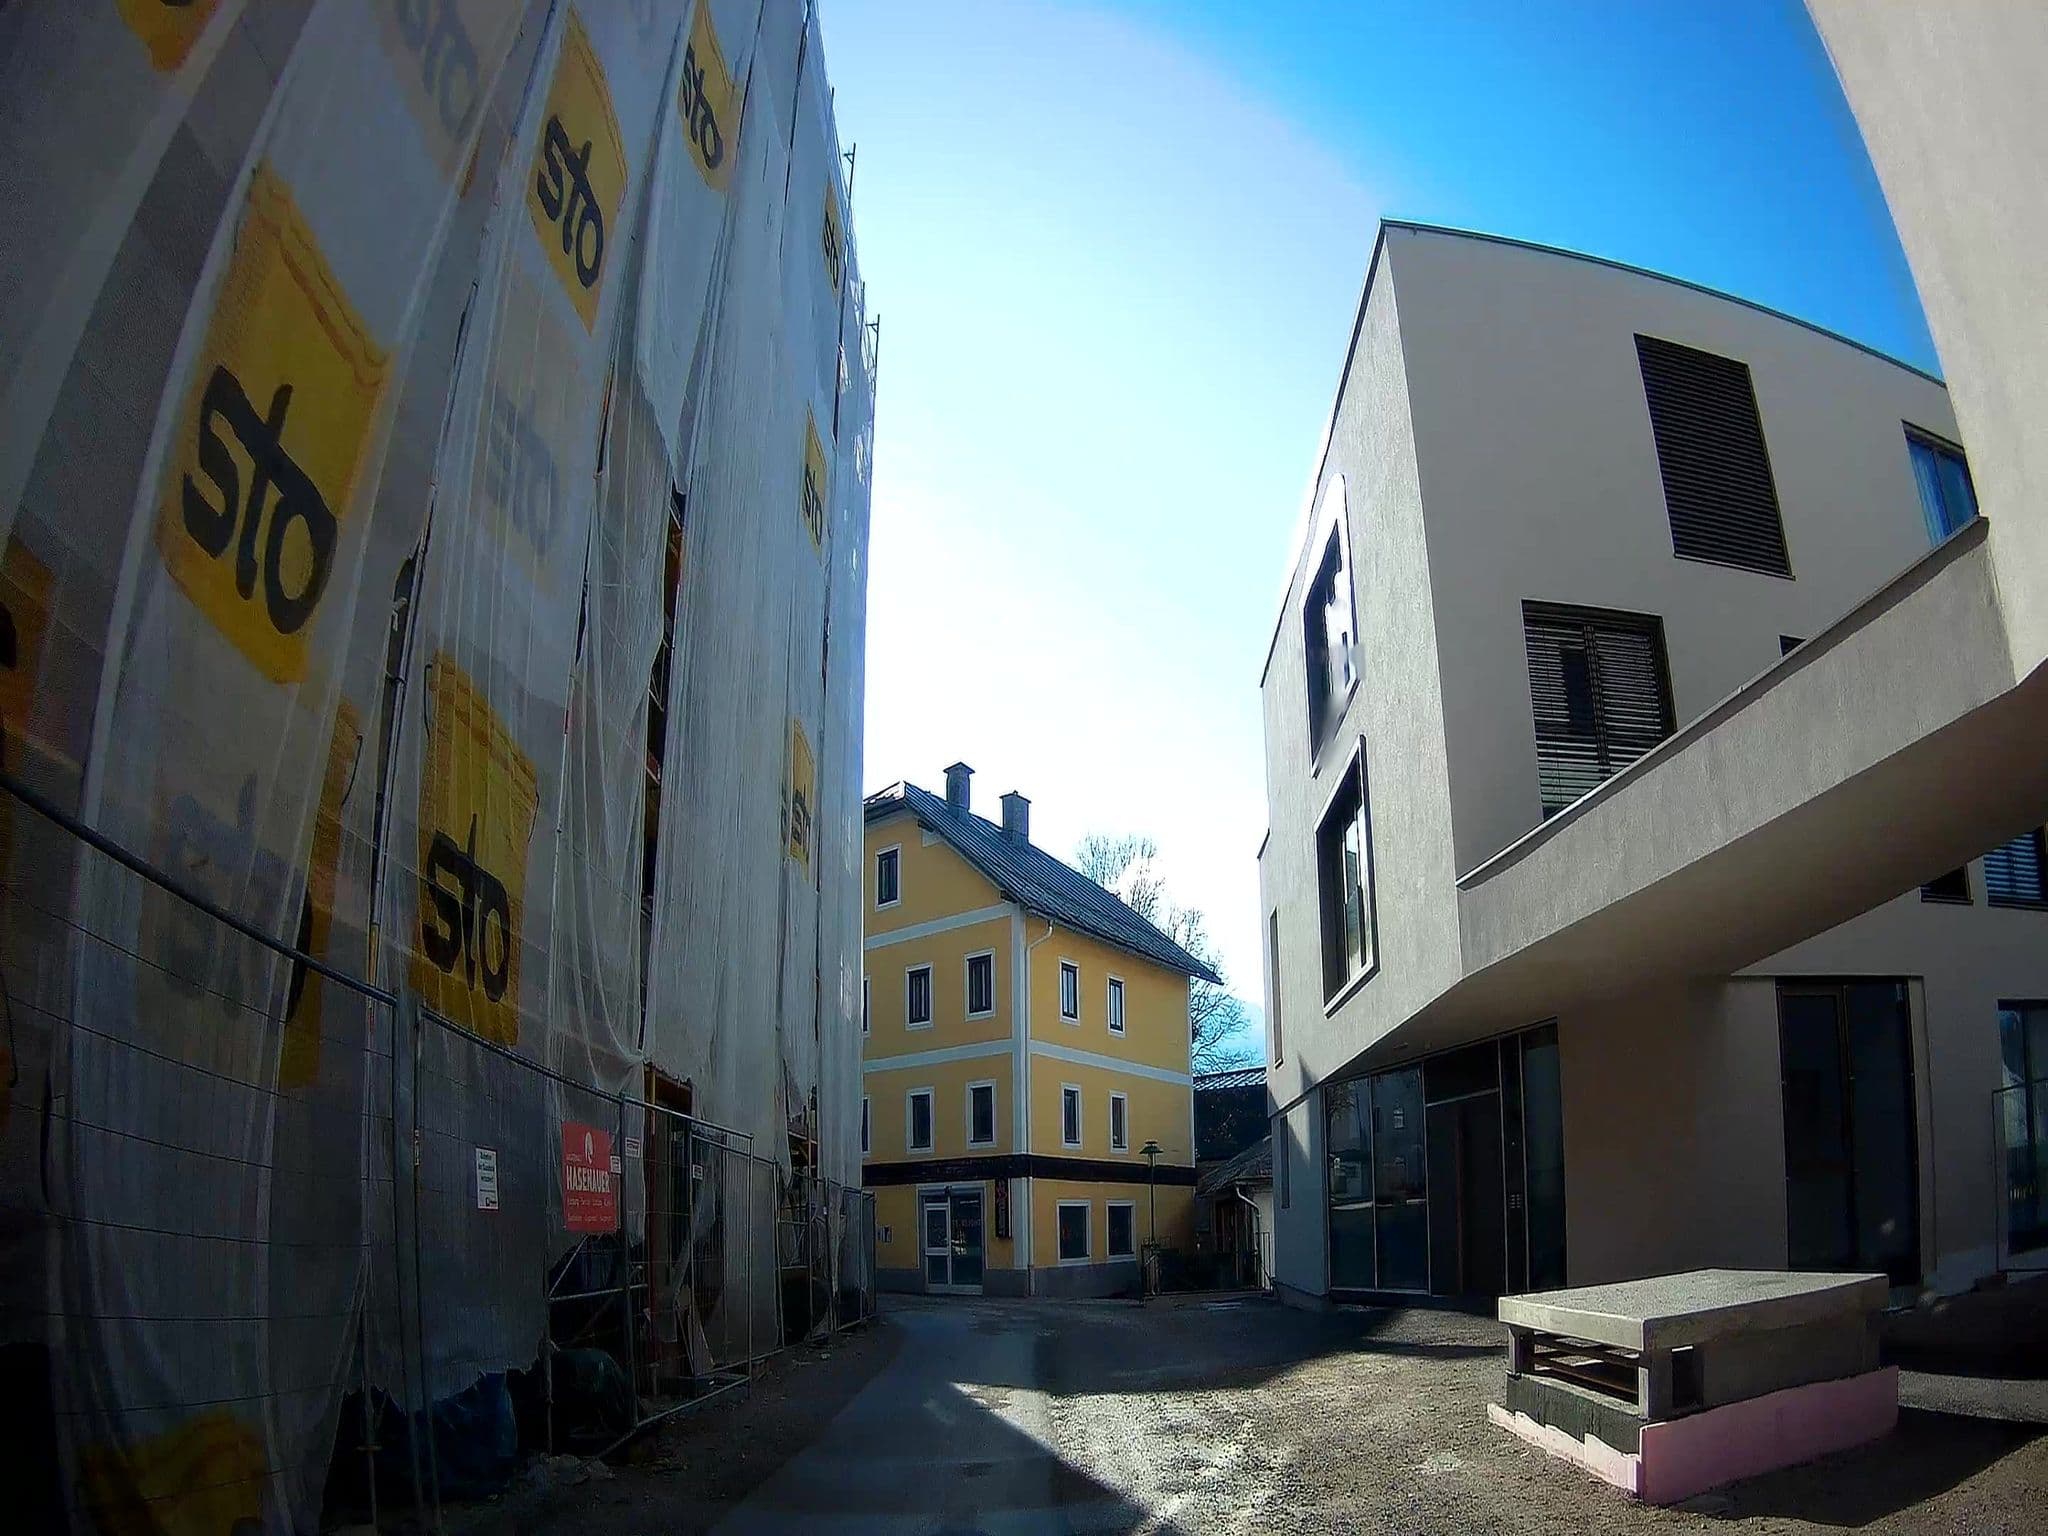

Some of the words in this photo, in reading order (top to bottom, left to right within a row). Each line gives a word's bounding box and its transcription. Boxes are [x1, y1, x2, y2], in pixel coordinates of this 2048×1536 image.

[682, 41, 724, 170] sto
[536, 113, 605, 290] sto
[823, 211, 840, 290] sto
[183, 364, 339, 635] sto
[803, 463, 823, 546] sto
[422, 812, 512, 1004] sto
[566, 1164, 611, 1194] HASENAUER
